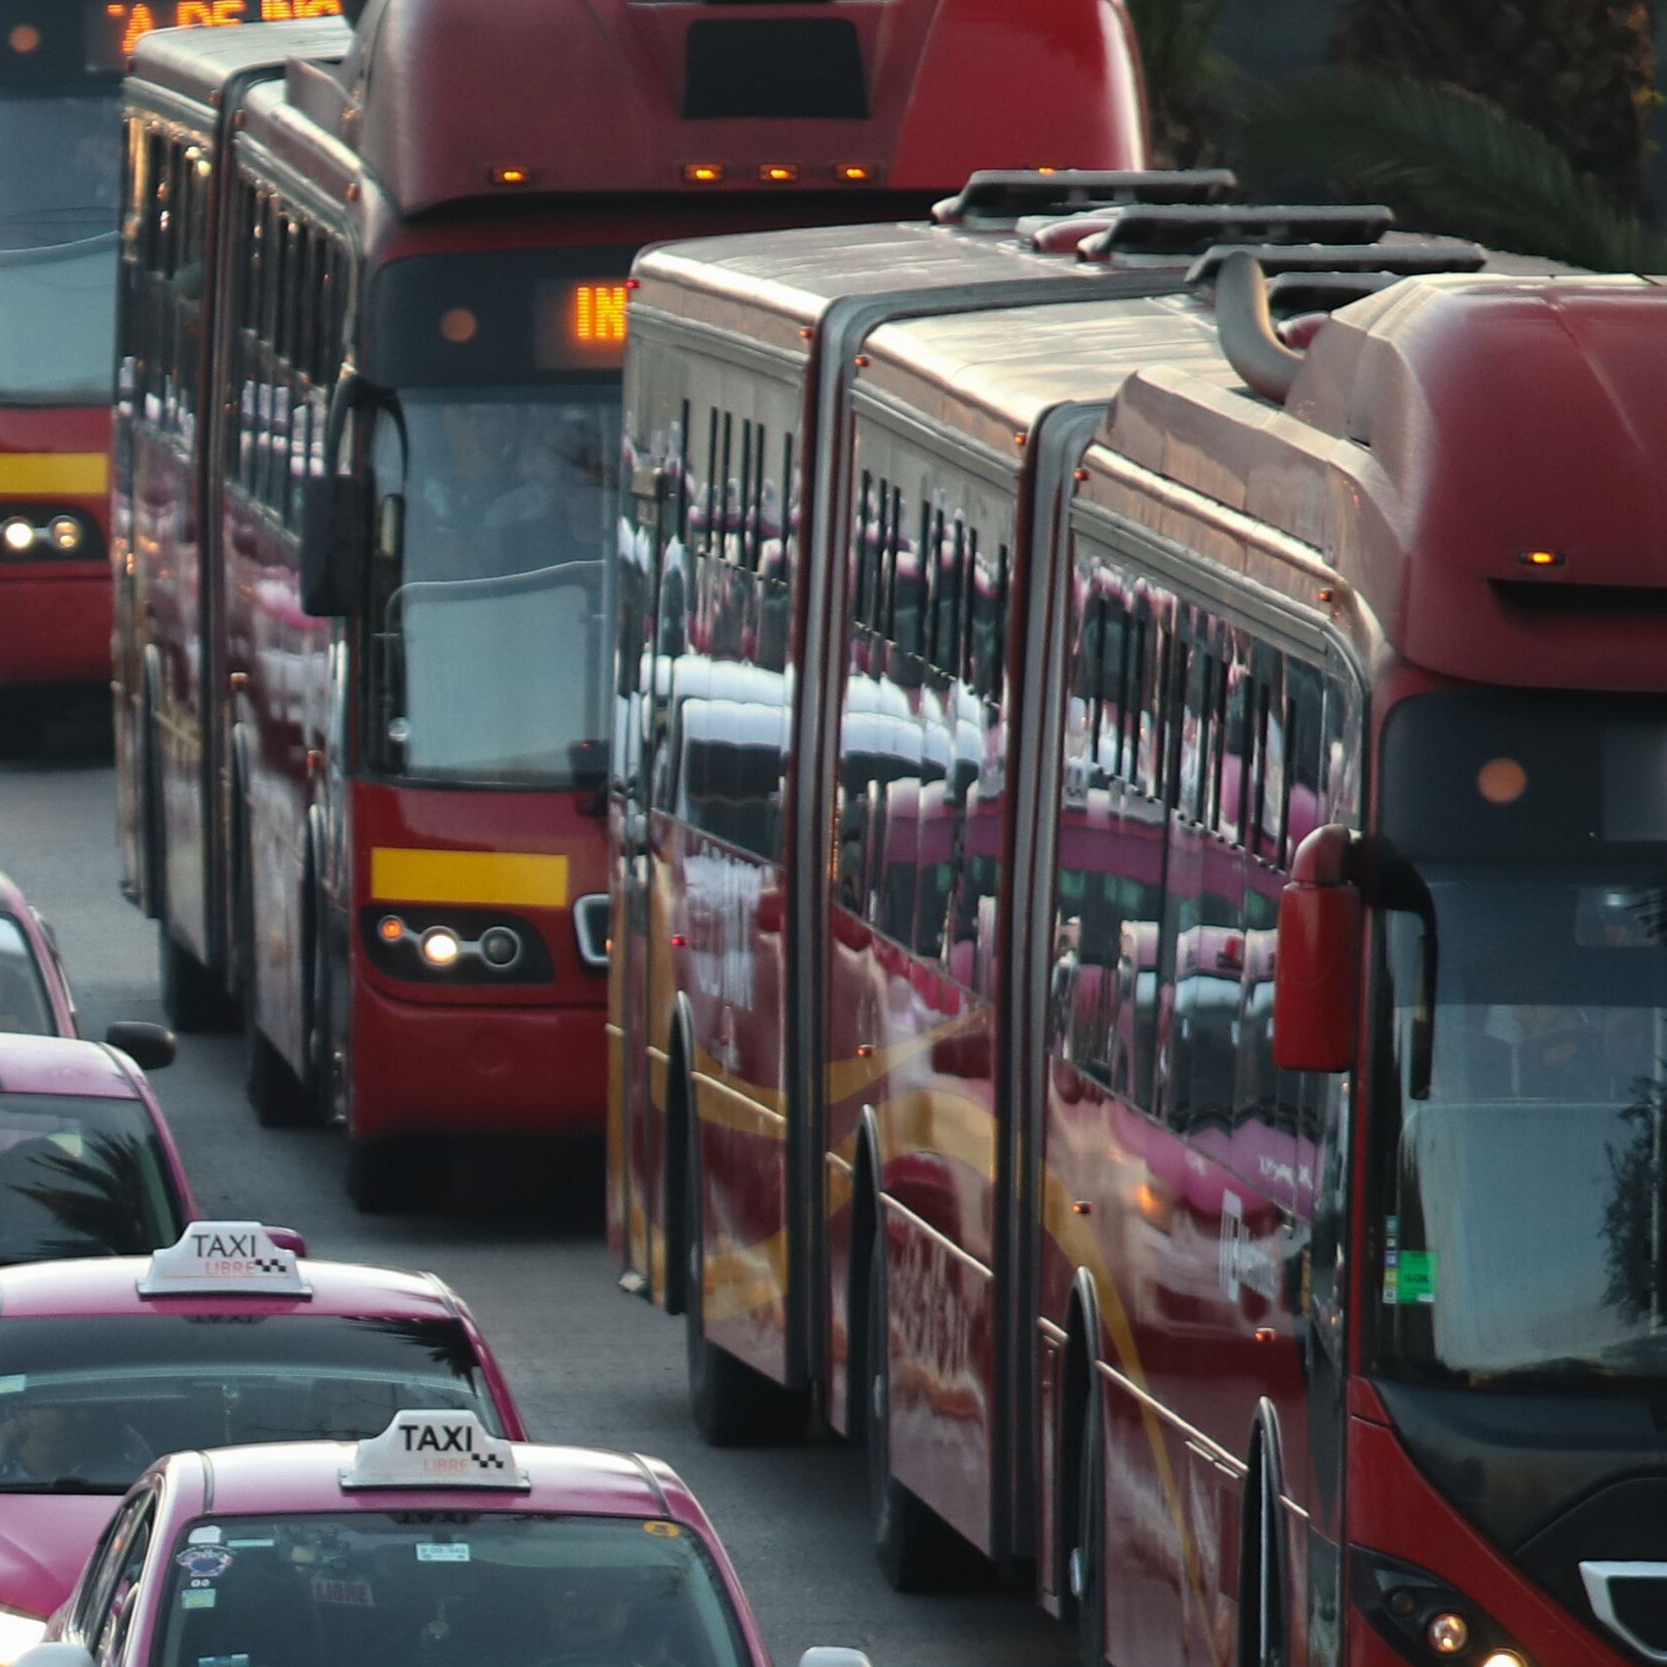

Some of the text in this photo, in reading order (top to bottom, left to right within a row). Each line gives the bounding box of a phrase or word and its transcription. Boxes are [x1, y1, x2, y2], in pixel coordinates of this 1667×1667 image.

[578, 286, 624, 337] IN
[191, 1235, 255, 1258] TAXI
[205, 1260, 255, 1275] LIBRE
[398, 1424, 473, 1452] TAXI
[423, 1458, 468, 1472] LIBRE
